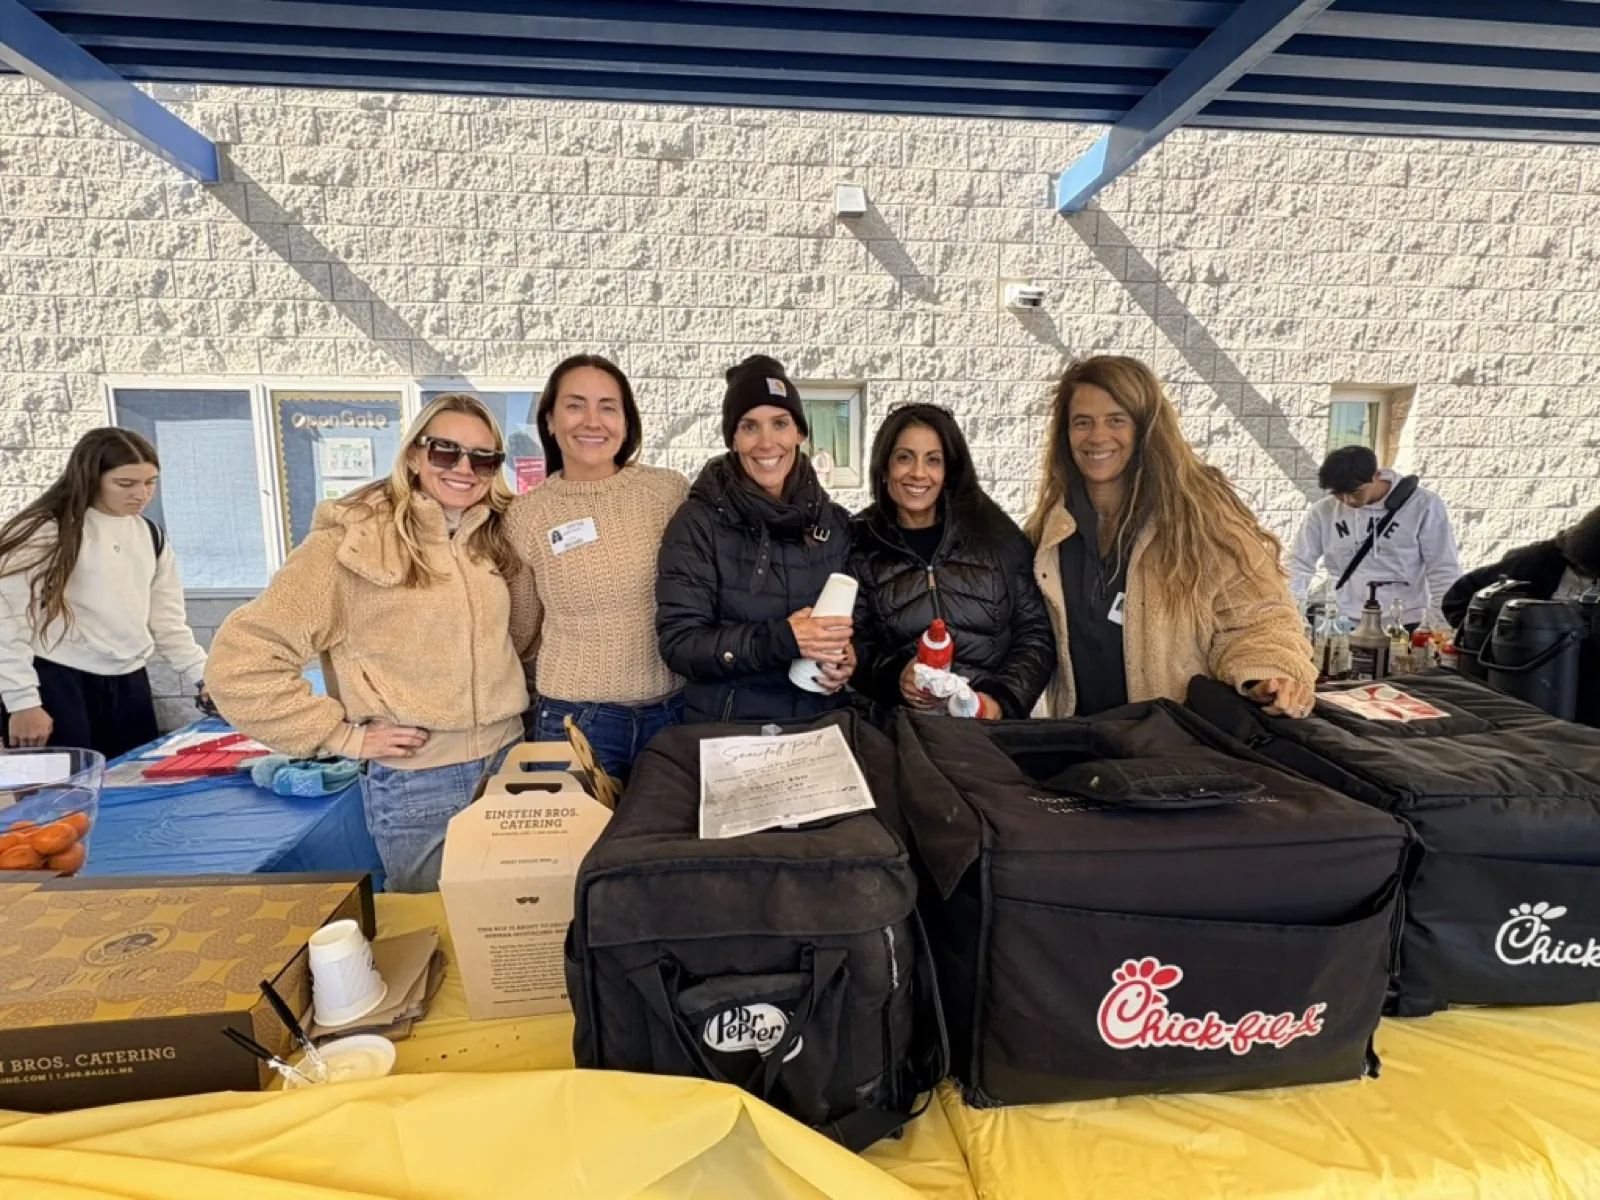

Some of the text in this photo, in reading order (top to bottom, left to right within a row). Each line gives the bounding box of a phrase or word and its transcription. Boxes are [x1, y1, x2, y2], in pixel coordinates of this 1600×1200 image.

[1335, 516, 1400, 539] NKE
[485, 807, 580, 820] EINSTEIN BROS.
[499, 819, 562, 830] CATERING
[738, 1007, 764, 1027] Dr
[1098, 957, 1327, 1056] Chick-fil-A
[11, 1056, 70, 1073] BROS.
[75, 1046, 176, 1067] CATERING
